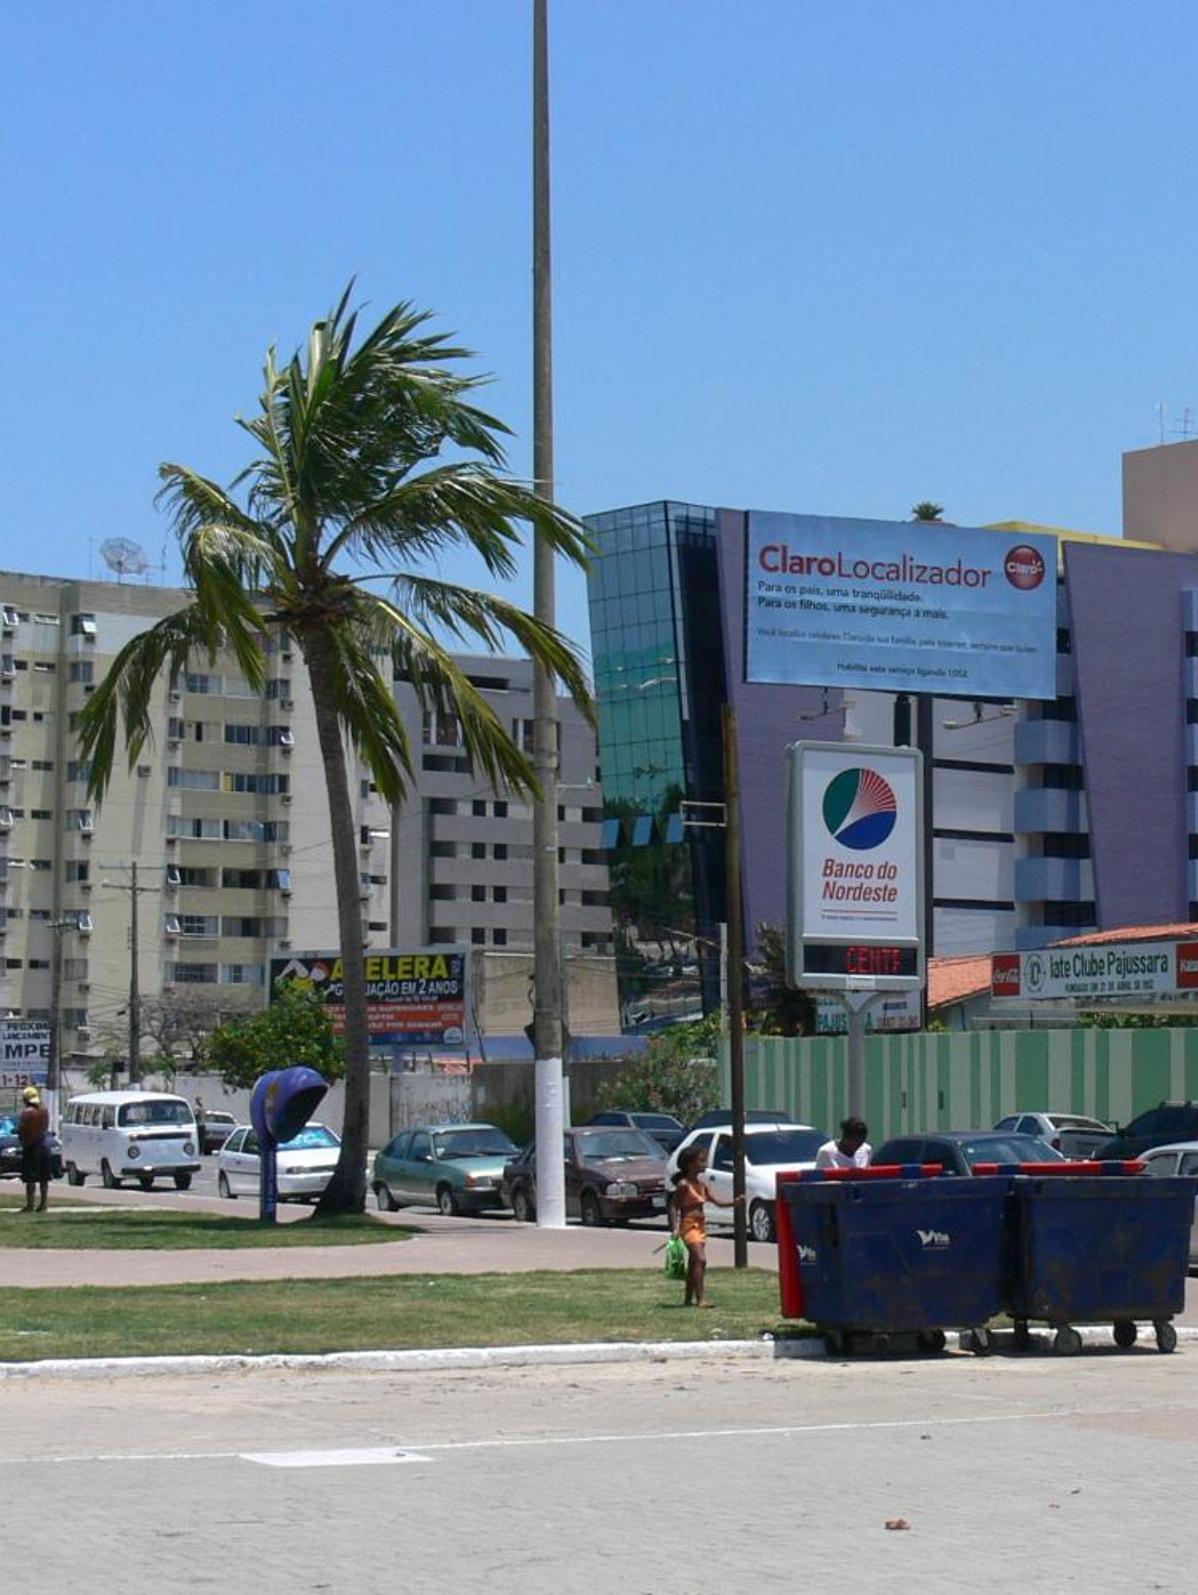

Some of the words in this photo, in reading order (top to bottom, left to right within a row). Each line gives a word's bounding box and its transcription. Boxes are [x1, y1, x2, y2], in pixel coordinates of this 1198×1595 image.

[758, 580, 782, 592] Para
[784, 585, 797, 594] os
[827, 589, 849, 598] uma
[758, 596, 782, 608] Para
[784, 600, 797, 609] os
[833, 603, 856, 612] uma
[822, 858, 873, 879] Banco
[877, 861, 897, 880] do
[822, 881, 898, 902] Nordeste
[330, 955, 448, 981] AELERA
[1050, 955, 1071, 978] Iate
[1073, 953, 1104, 978] Clube
[1107, 950, 1168, 979] Pajussara
[401, 981, 416, 993] EM
[419, 978, 426, 995] 2
[428, 980, 458, 994] ANOS
